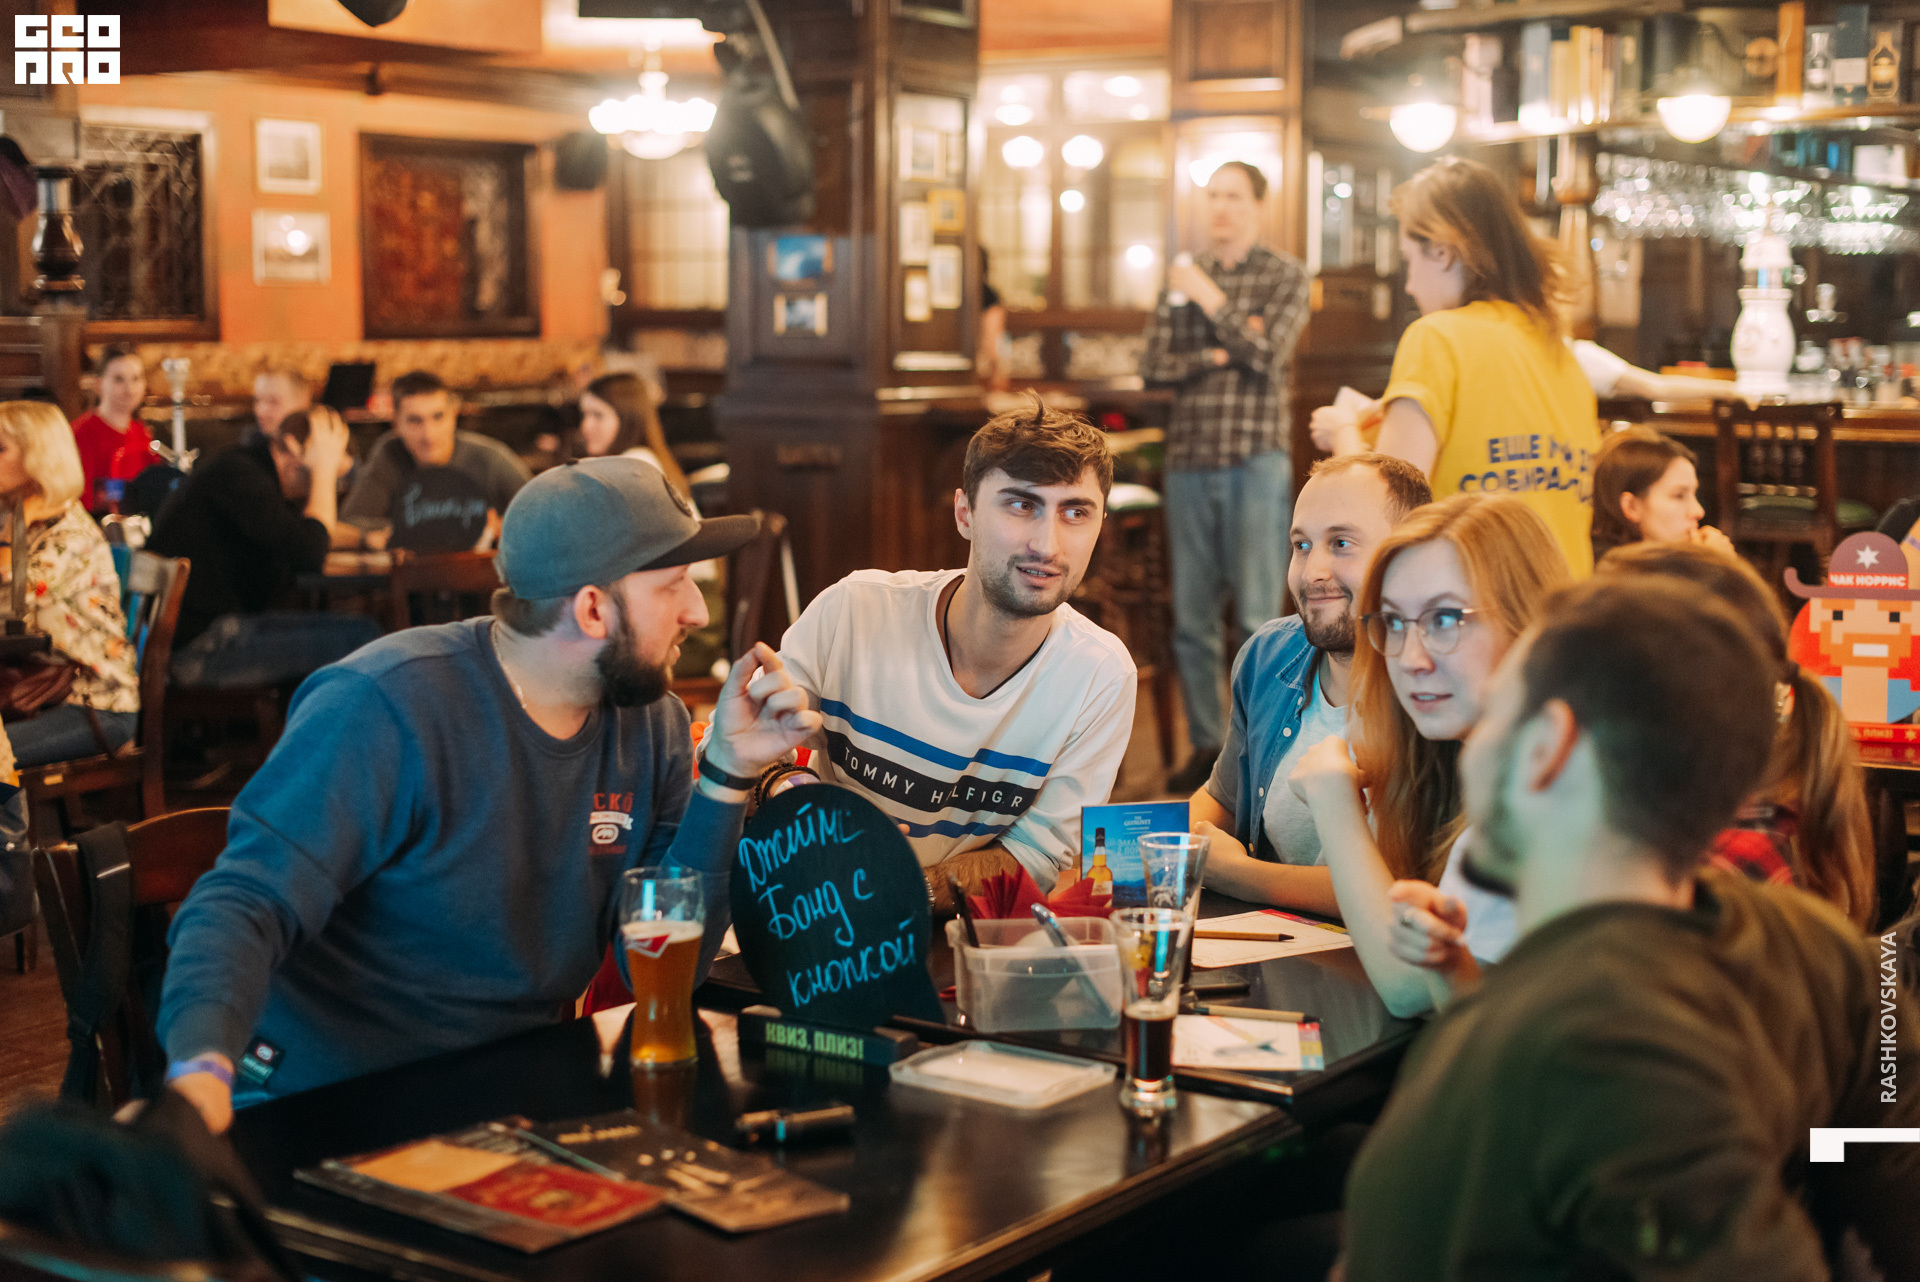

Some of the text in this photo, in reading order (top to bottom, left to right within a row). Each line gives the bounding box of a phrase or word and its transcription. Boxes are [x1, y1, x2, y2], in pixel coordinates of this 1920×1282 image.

[1829, 573, 1906, 587] ЧАК НОРРИС
[844, 746, 915, 795] TOMMY
[758, 880, 855, 947] Бонд
[765, 1022, 864, 1060] КВИЗ, ПЛИЗ!
